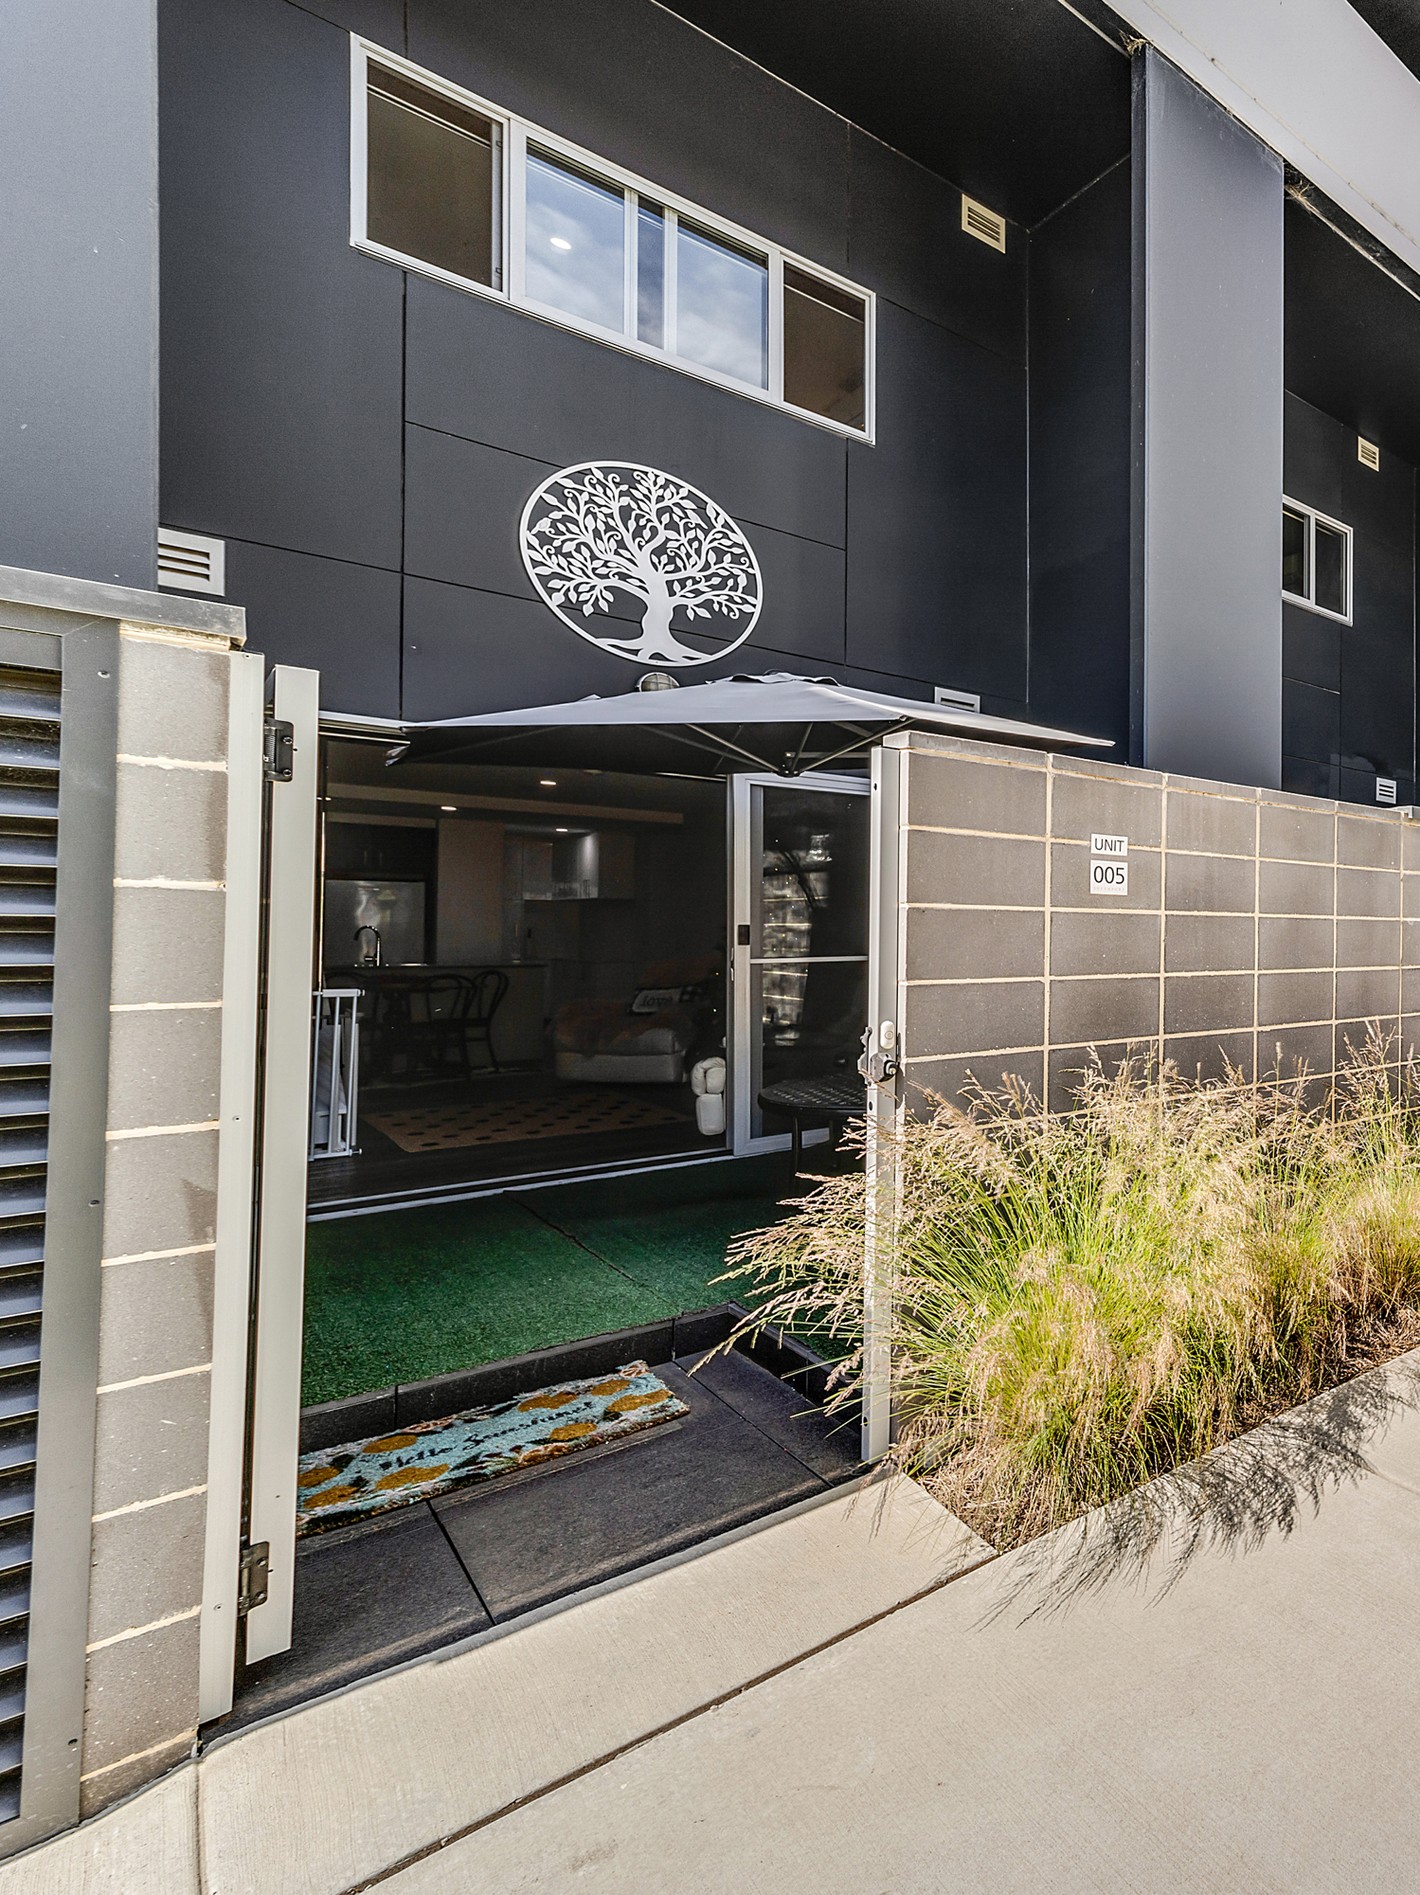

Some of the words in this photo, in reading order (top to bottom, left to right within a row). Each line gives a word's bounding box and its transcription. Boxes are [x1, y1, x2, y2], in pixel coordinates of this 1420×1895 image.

[1094, 838, 1125, 852] UNIT
[1093, 865, 1125, 885] 005
[379, 1446, 455, 1471] Hello
